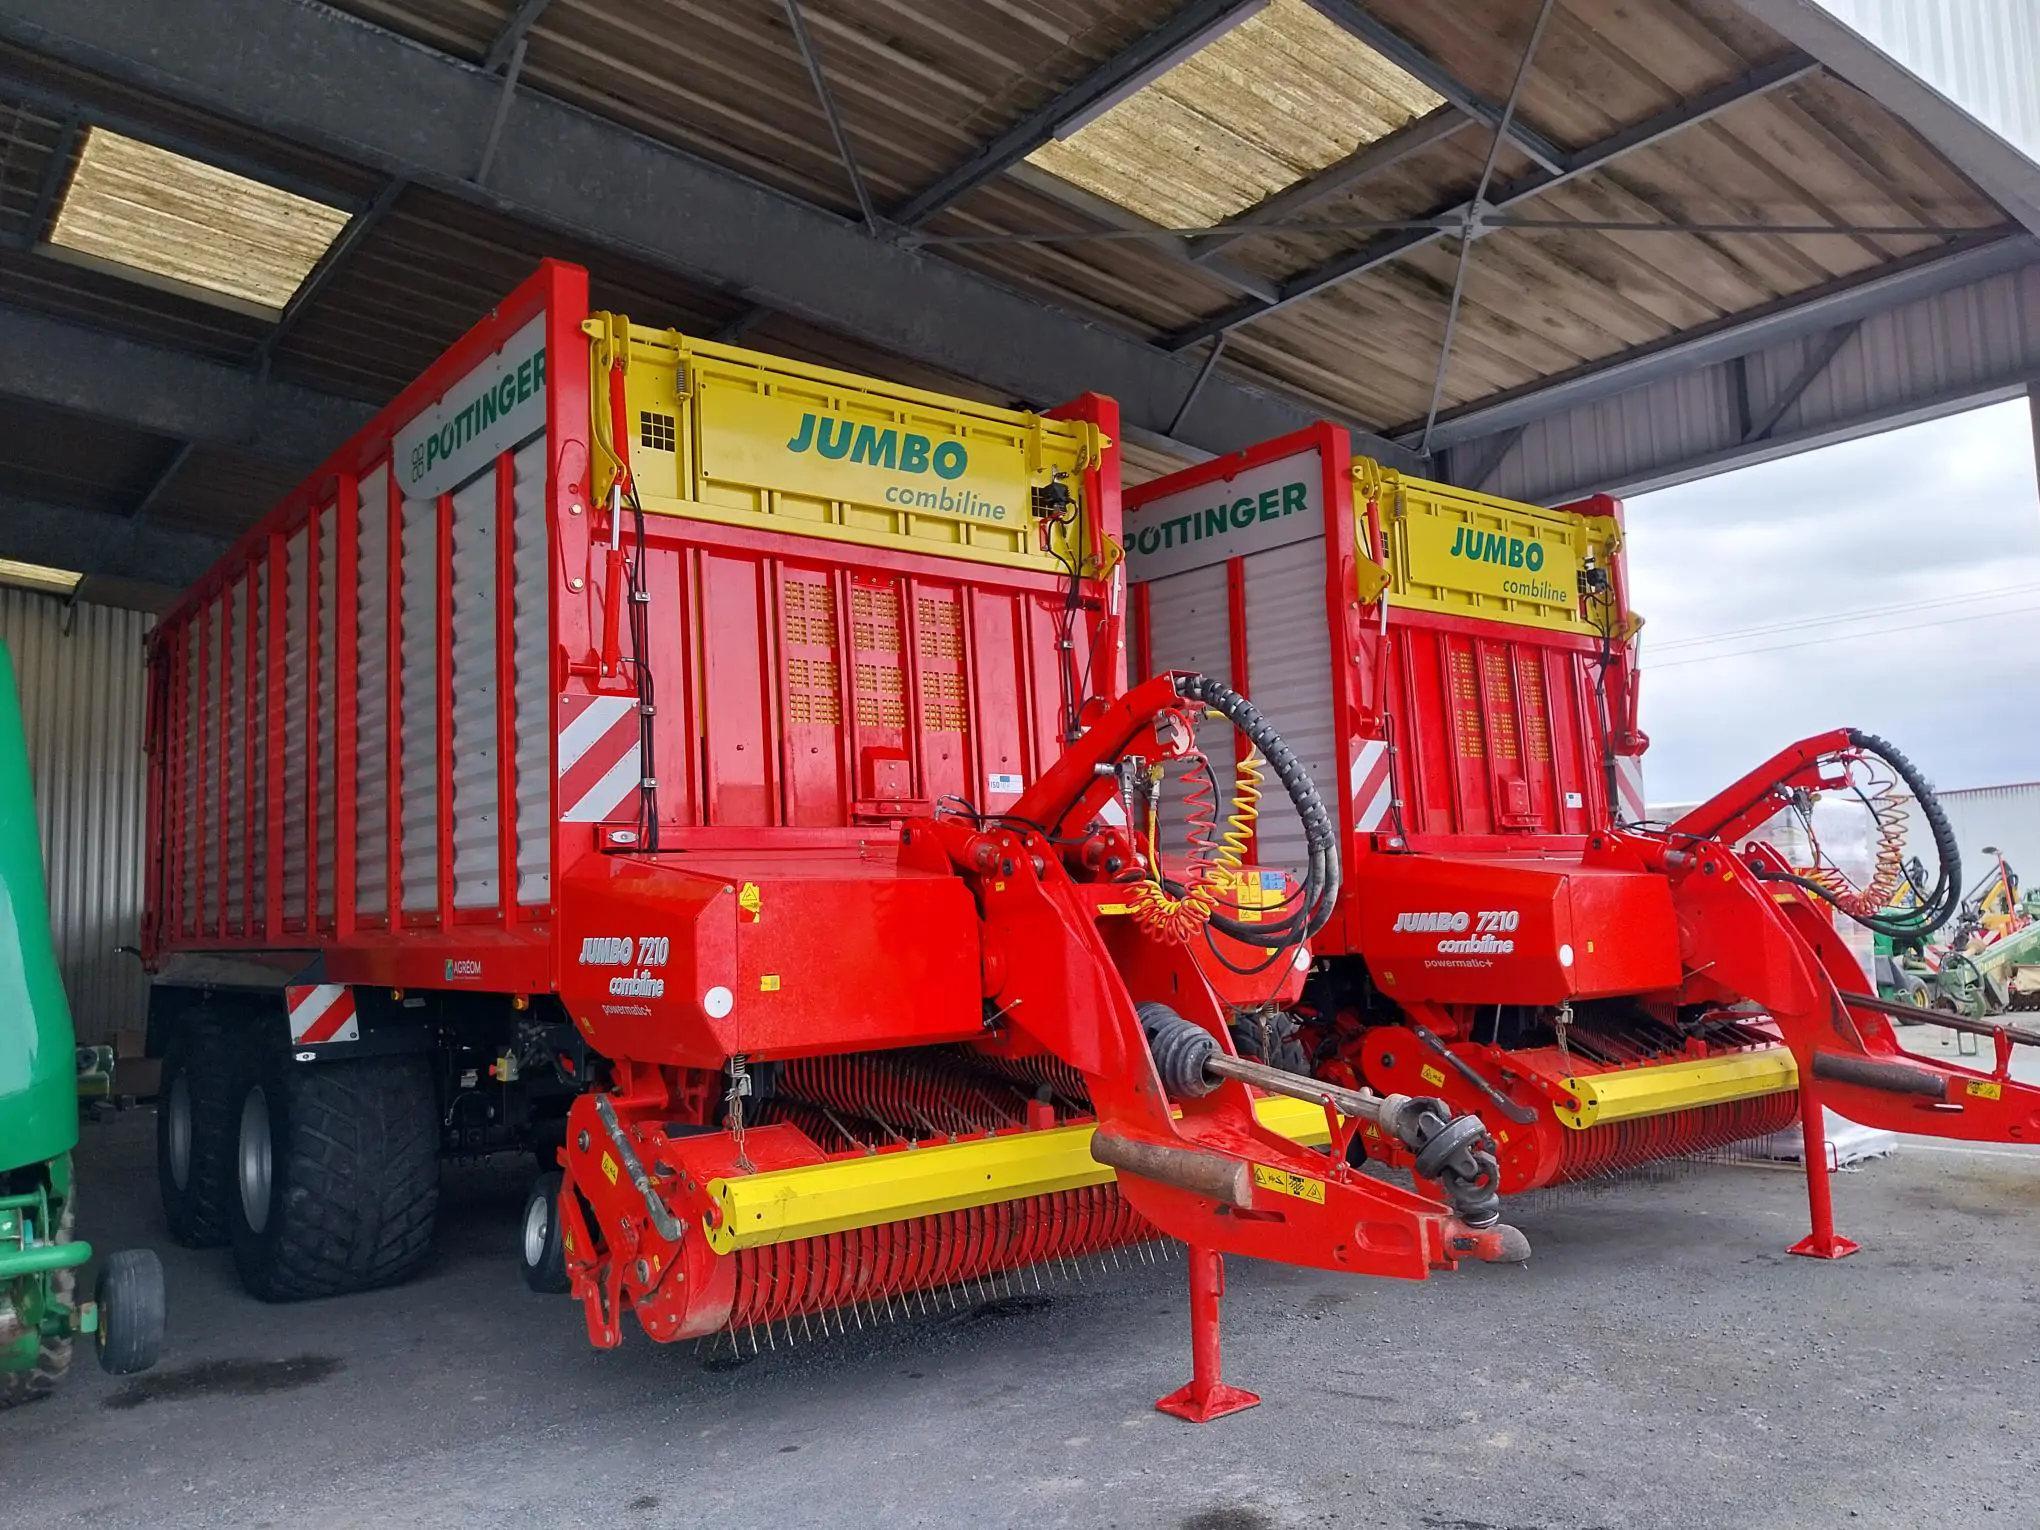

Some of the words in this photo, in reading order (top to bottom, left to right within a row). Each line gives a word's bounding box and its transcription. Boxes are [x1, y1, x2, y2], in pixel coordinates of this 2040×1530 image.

[427, 347, 547, 472] PÖTTINGER
[787, 412, 969, 480] JUMBO
[885, 486, 1006, 520] combiline
[1450, 526, 1544, 572] JUMBO
[1503, 578, 1567, 602] combiline
[1393, 911, 1470, 932] JUMBO
[1476, 910, 1520, 932] 7210
[578, 936, 634, 966] JUMBO
[637, 936, 670, 966] 7210
[1437, 933, 1515, 954] combiline
[1424, 958, 1494, 969] powermatic+
[609, 969, 665, 999] combiline
